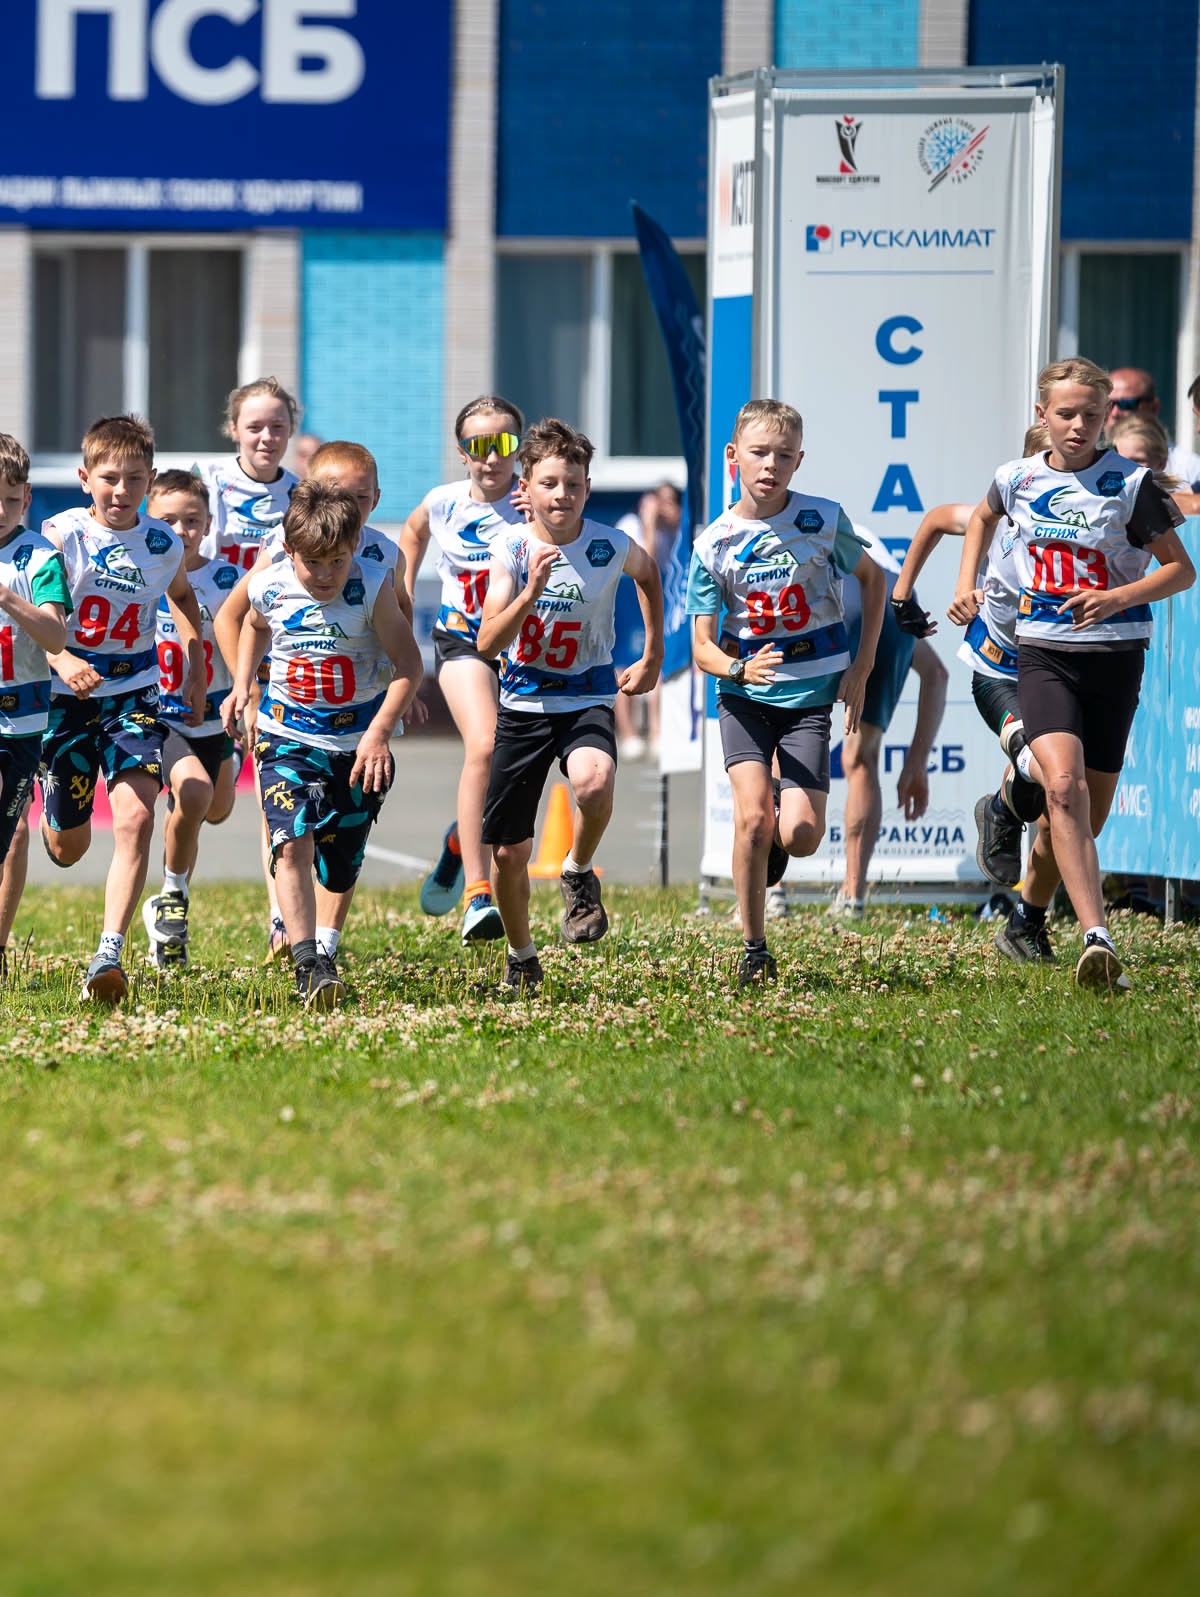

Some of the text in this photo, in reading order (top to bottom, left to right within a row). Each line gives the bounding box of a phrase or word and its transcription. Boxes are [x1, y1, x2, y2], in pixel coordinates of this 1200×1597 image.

[36, 0, 364, 104] ПСБ
[840, 228, 996, 249] РУСКЛИМАТ
[1034, 526, 1079, 539] СТРИЖ
[95, 577, 139, 594] СТРИЖ
[747, 566, 791, 584] СТРИЖ
[1028, 542, 1108, 595] 103
[74, 595, 142, 649] 94
[744, 583, 811, 635] 99
[292, 639, 337, 650] СТРИЖ
[517, 614, 582, 669] 85
[286, 655, 356, 705] 90
[829, 826, 965, 847] БРАКУДА
